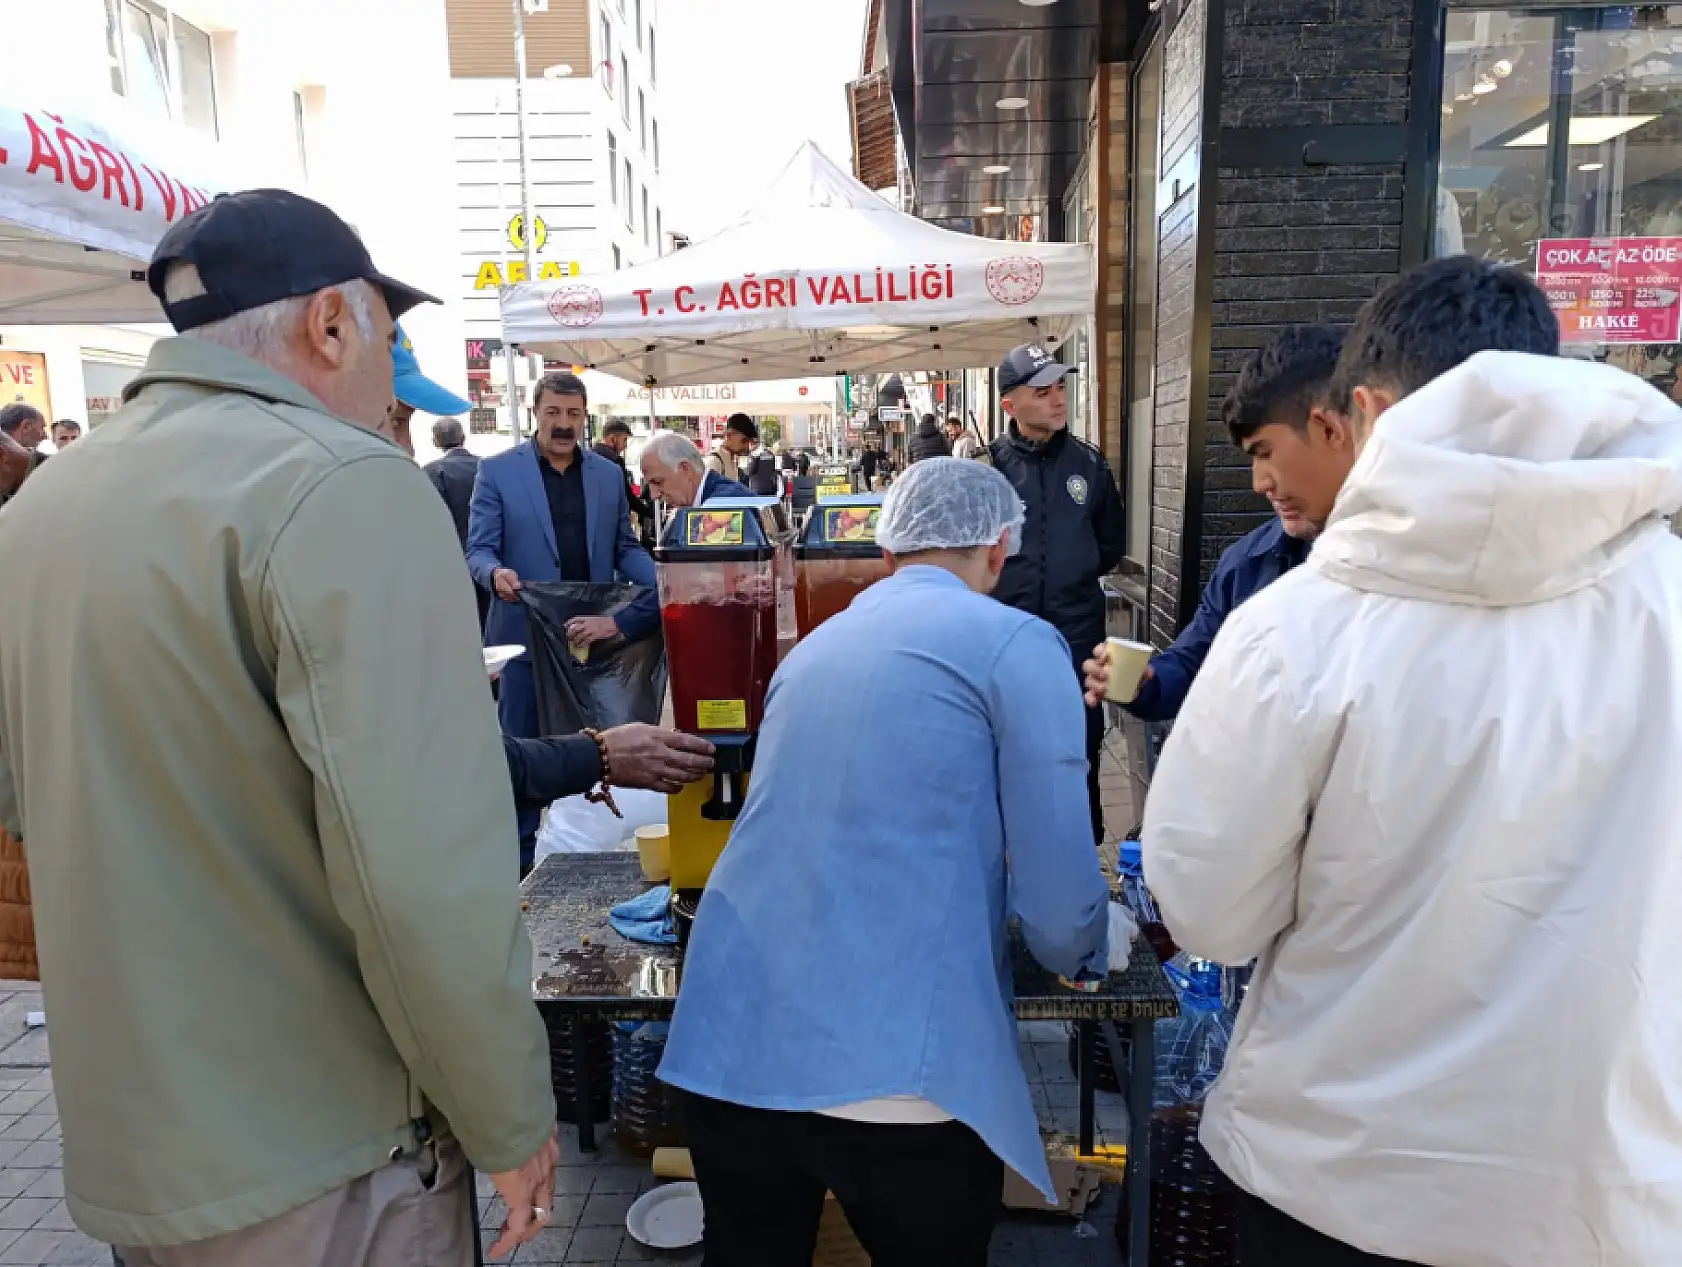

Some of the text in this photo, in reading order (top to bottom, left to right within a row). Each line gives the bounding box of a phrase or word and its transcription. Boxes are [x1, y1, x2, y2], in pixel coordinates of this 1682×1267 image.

[22, 109, 144, 212] AĞRI
[1546, 248, 1581, 268] ÇOK
[1615, 248, 1638, 263] AZ
[1642, 245, 1678, 264] ÖDE
[632, 289, 665, 316] T.
[674, 285, 706, 312] C.
[717, 272, 797, 311] AĞRI
[806, 263, 954, 305] VALİLİĞİ
